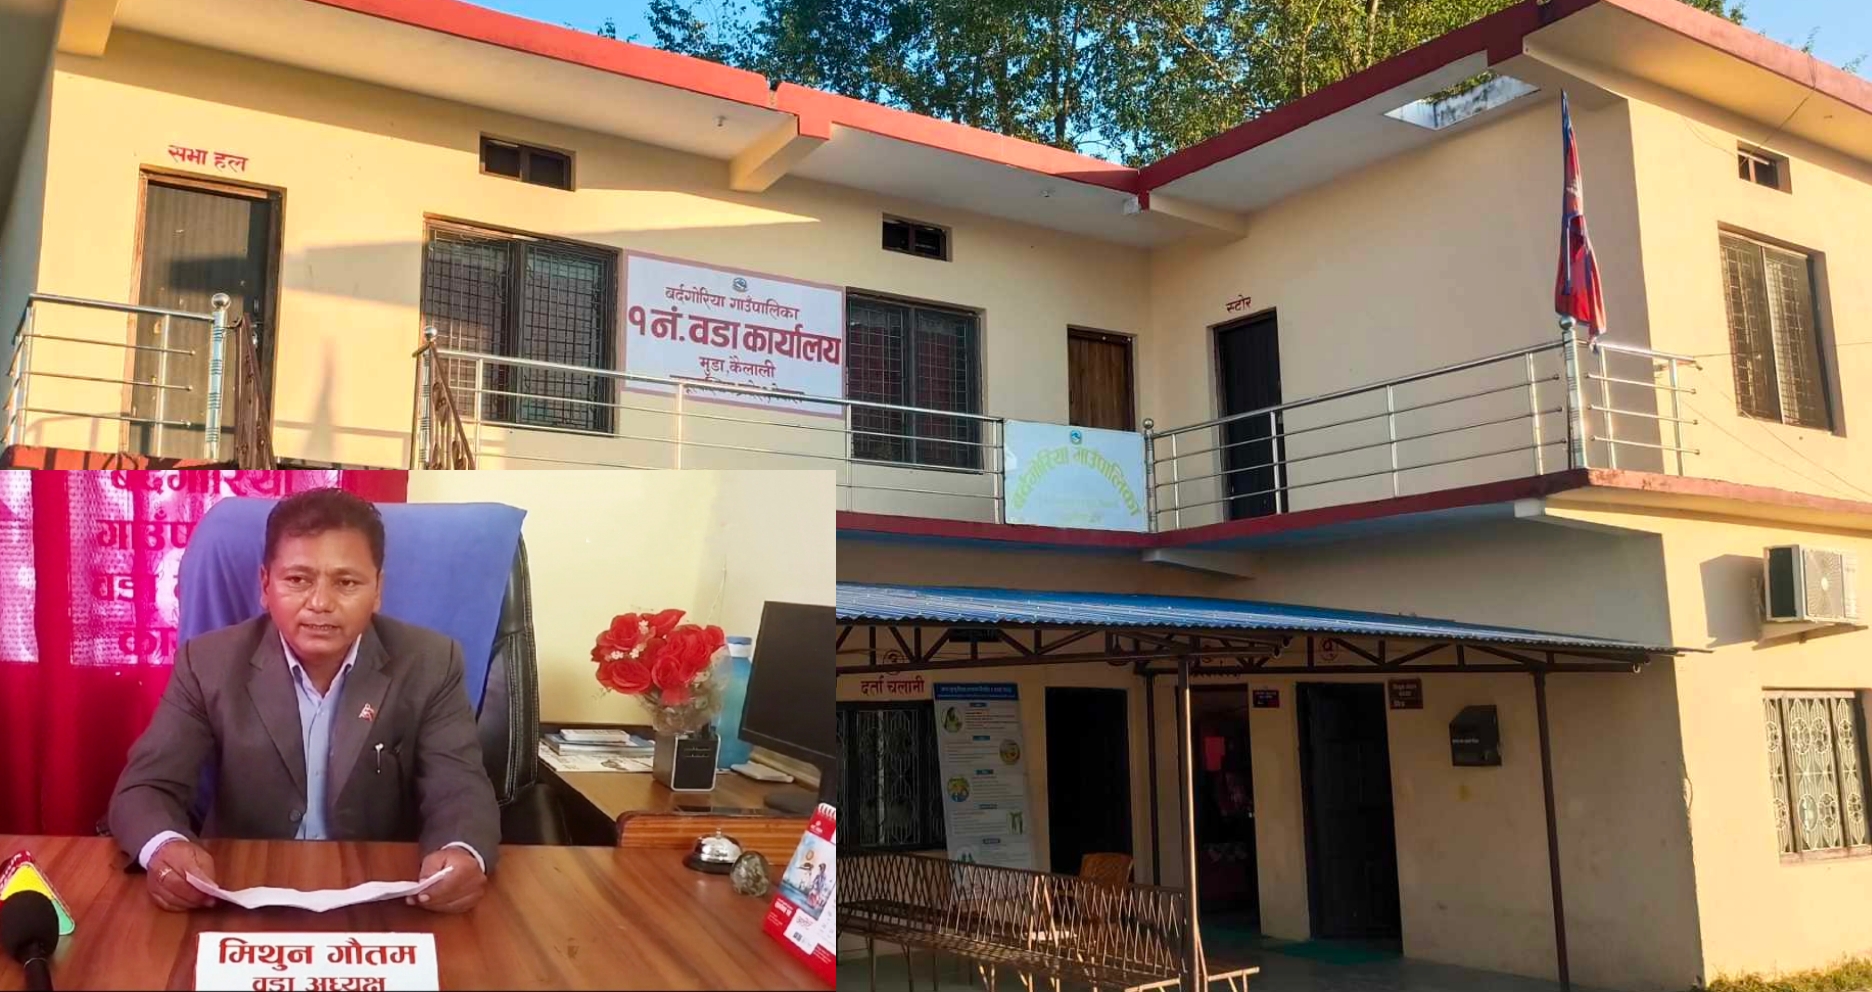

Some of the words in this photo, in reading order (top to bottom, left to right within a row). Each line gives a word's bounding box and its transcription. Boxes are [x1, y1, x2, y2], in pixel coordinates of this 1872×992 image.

[168, 144, 208, 165] सभा
[213, 151, 249, 172] हल
[665, 283, 725, 310] बर्दगोरिया
[729, 295, 799, 320] गाउँपालिका
[1226, 294, 1251, 312] स्टोर
[688, 314, 741, 350] वडा
[742, 322, 842, 365] कार्यालय
[861, 675, 884, 696] दर्ता
[886, 674, 925, 696] चलानी
[219, 937, 315, 971] मिथुन
[326, 937, 418, 965] गौतम
[252, 977, 296, 991] वडा
